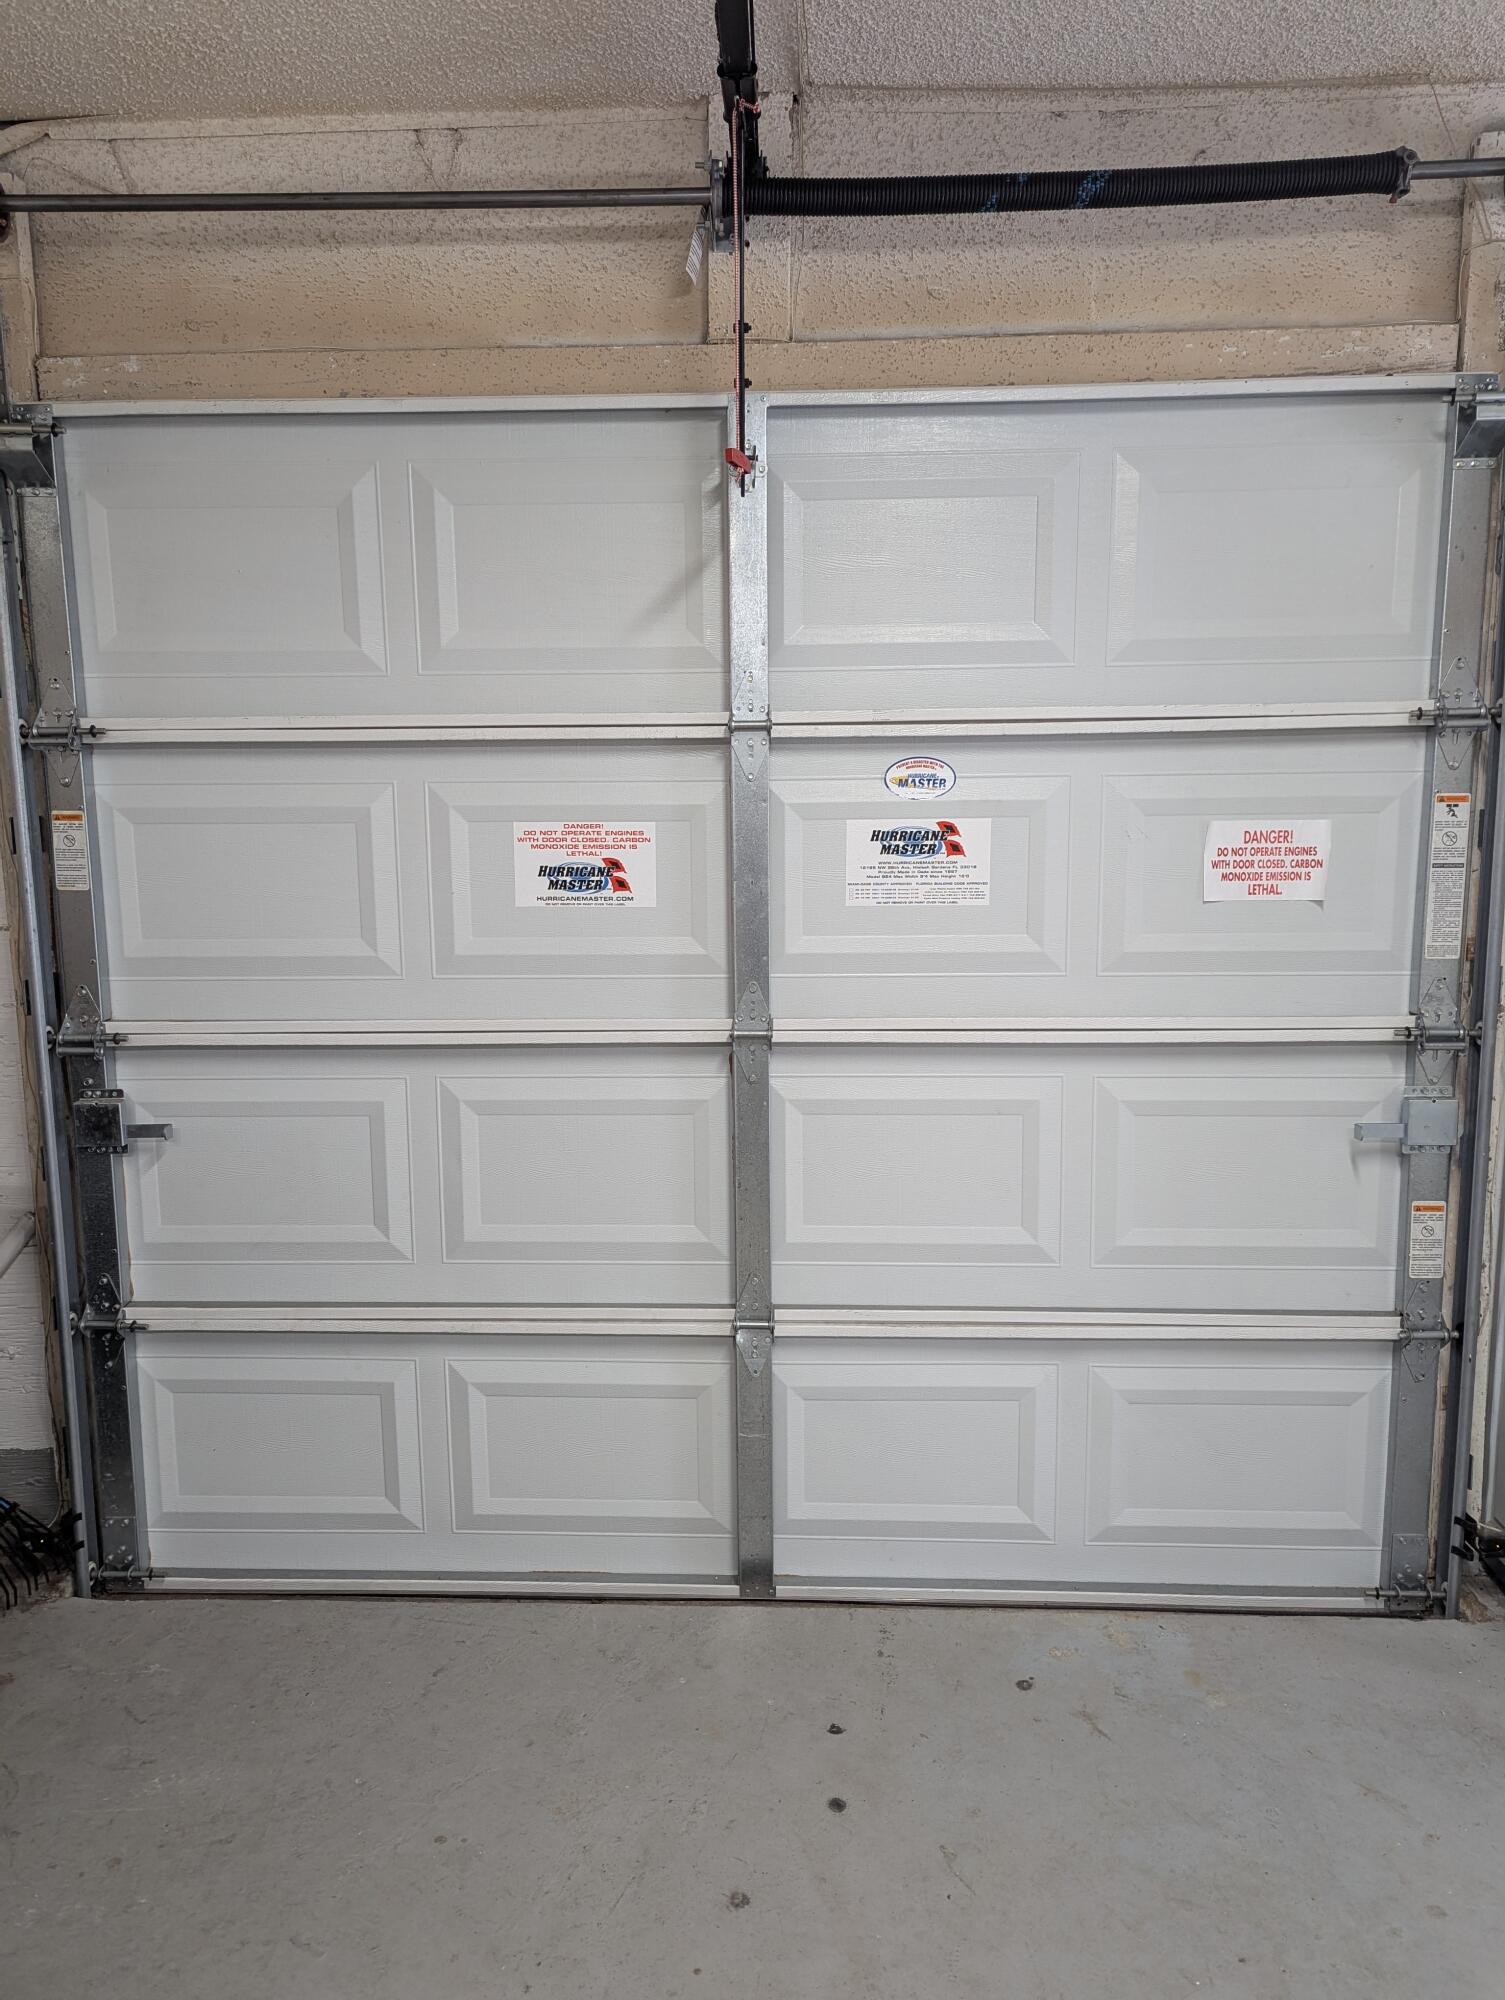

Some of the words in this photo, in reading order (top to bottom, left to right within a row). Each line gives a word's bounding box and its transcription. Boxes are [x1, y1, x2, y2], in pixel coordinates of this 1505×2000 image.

[898, 778, 946, 788] MASTER
[870, 830, 950, 841] HURRICANE
[1244, 830, 1294, 844] DANGER!
[880, 844, 937, 854] MASTER
[1217, 847, 1229, 857] DO
[1231, 847, 1248, 856] NOT
[1250, 847, 1282, 856] OPERATE
[1284, 846, 1317, 856] ENGINES
[1211, 860, 1230, 869] WITH
[1233, 860, 1254, 869] DOOR
[1290, 859, 1324, 868] CARBON
[538, 865, 615, 877] HURRICANE
[1221, 872, 1263, 881] MONOXIDE
[1266, 872, 1301, 881] EMISSION
[1304, 872, 1311, 881] IS
[548, 880, 603, 890] MASTER
[1248, 884, 1282, 895] LETHAL.
